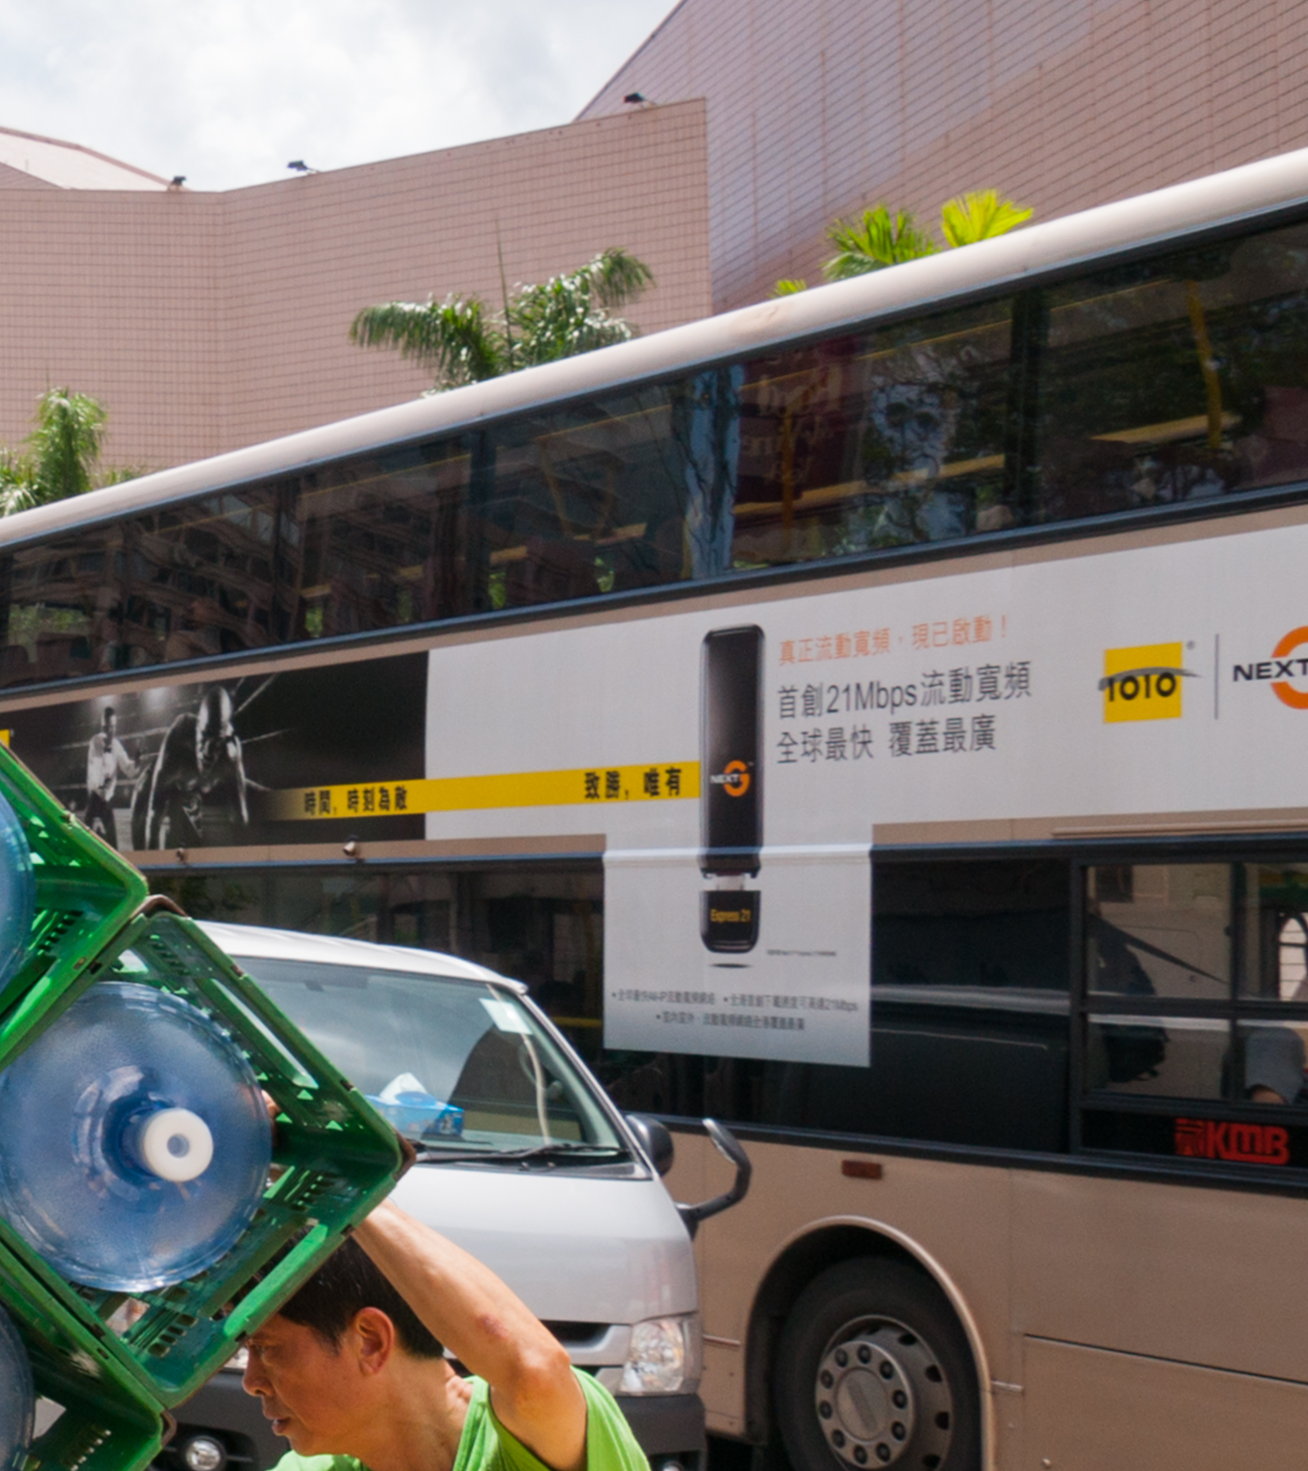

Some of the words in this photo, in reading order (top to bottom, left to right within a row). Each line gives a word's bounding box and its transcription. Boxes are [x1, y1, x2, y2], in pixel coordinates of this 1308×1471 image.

[777, 660, 1033, 720] 首創21Mbps流動寬頻
[776, 724, 875, 764] 全球最快
[888, 713, 997, 758] 覆蓋最廣
[1206, 1121, 1290, 1165] KMB
